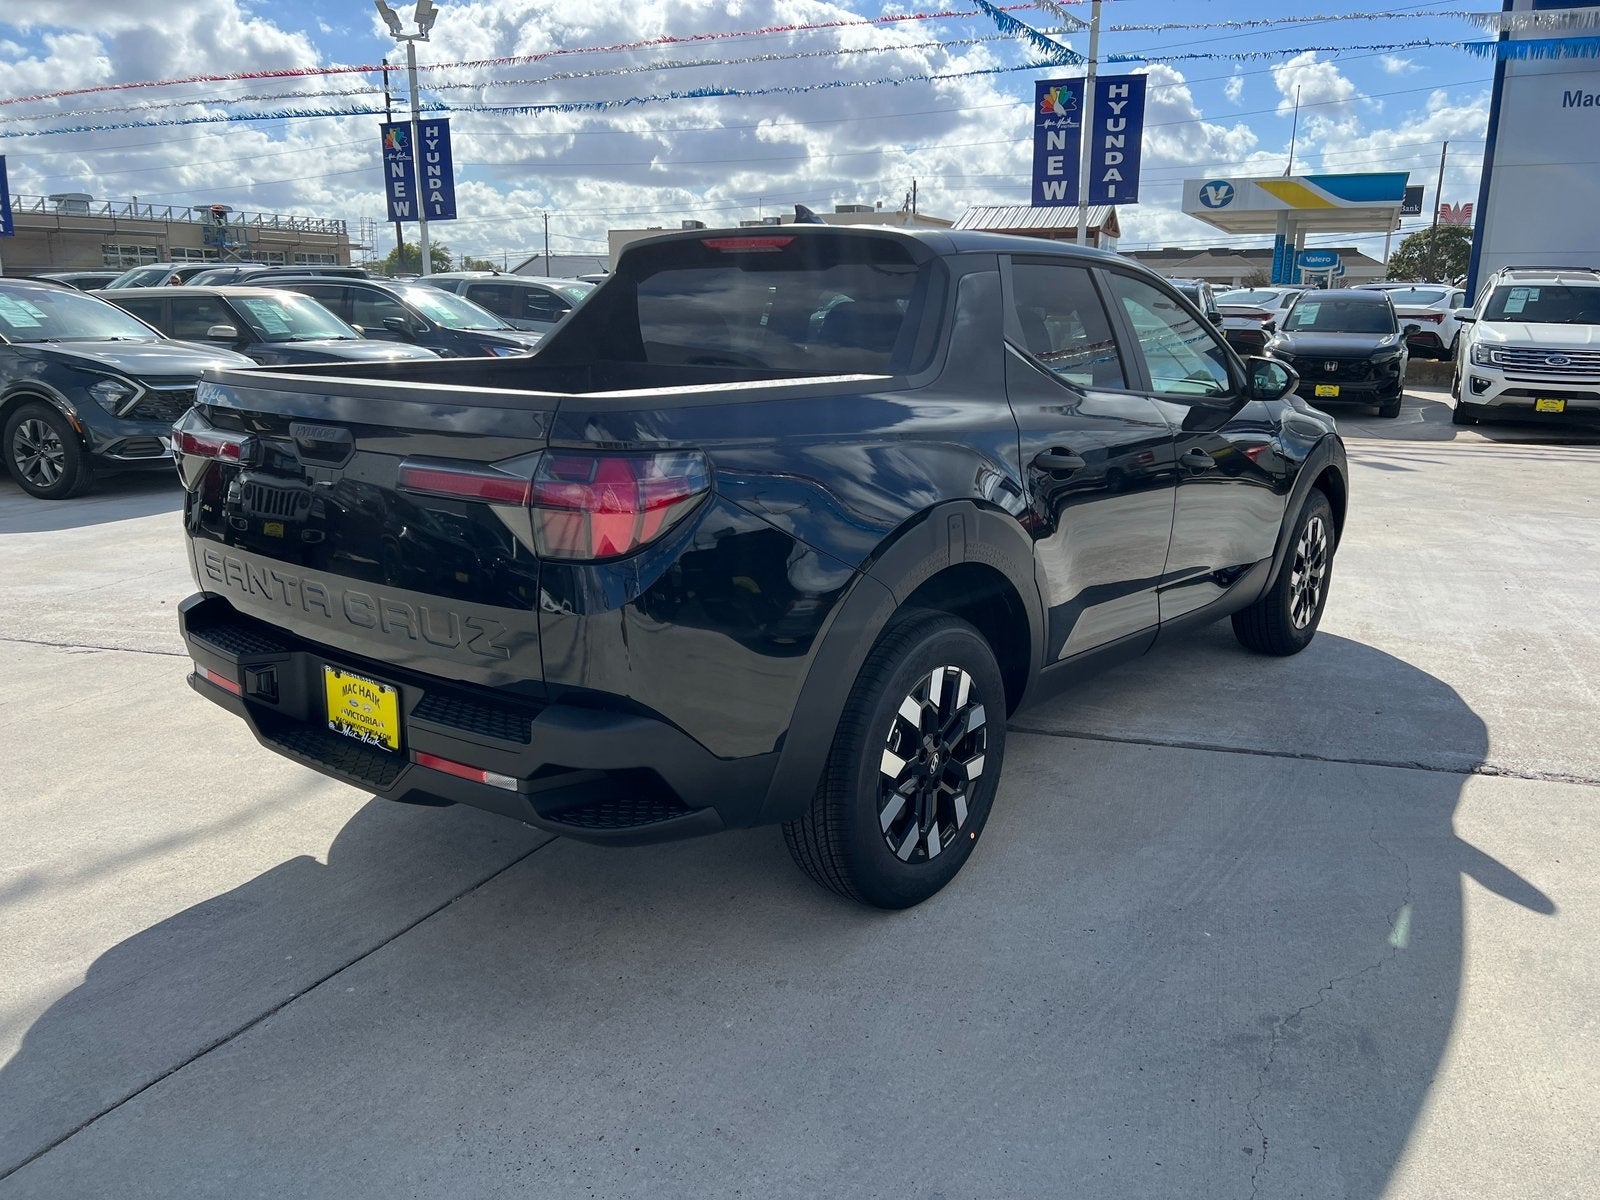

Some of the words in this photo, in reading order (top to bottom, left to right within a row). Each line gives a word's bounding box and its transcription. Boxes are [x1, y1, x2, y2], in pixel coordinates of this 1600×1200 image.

[425, 126, 444, 215] HYUNDAI
[1042, 130, 1068, 201] NEW
[1102, 84, 1129, 198] HYUNDAI
[391, 162, 410, 217] NEW
[1305, 255, 1332, 264] Valero
[203, 548, 333, 618] SANTA
[342, 588, 512, 660] CRUZ
[342, 683, 357, 697] MAC
